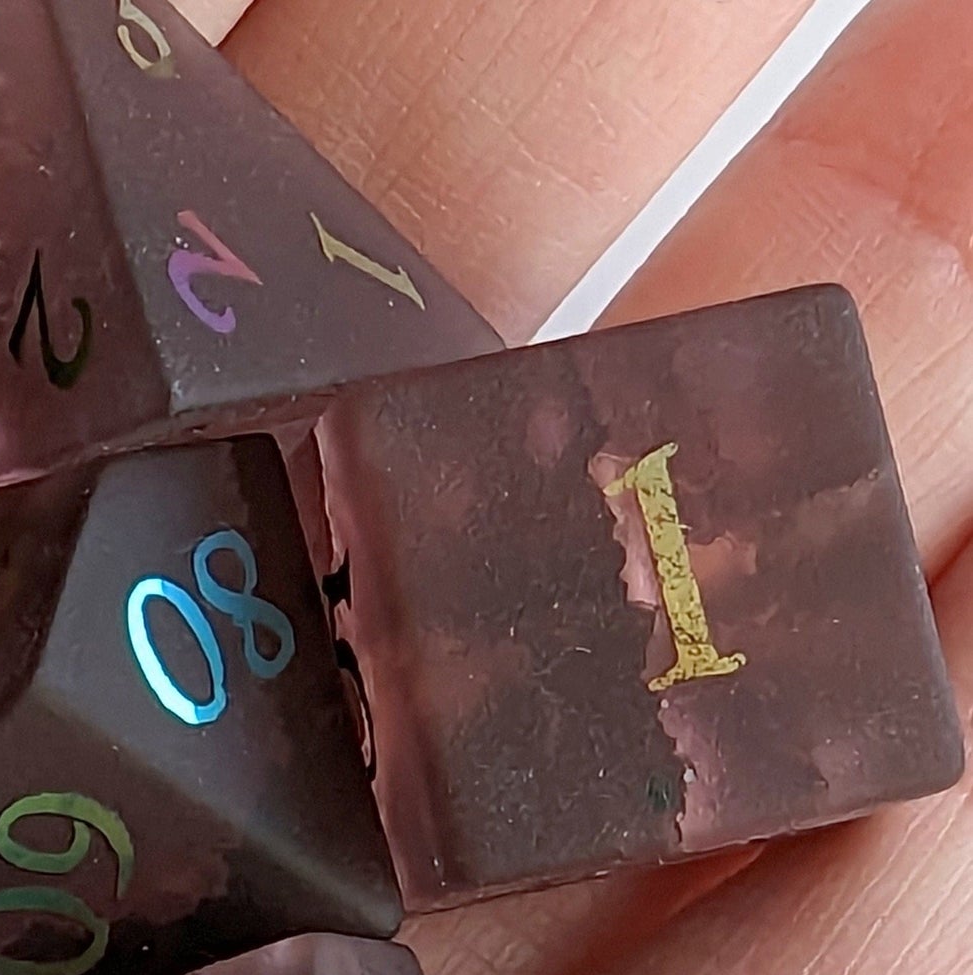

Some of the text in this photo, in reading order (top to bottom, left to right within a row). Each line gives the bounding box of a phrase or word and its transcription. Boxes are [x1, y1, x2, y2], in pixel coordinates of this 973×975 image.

[8, 247, 93, 390] 2
[167, 209, 264, 334] 2
[309, 211, 426, 311] 1
[127, 529, 296, 726] 80
[603, 441, 747, 692] 1
